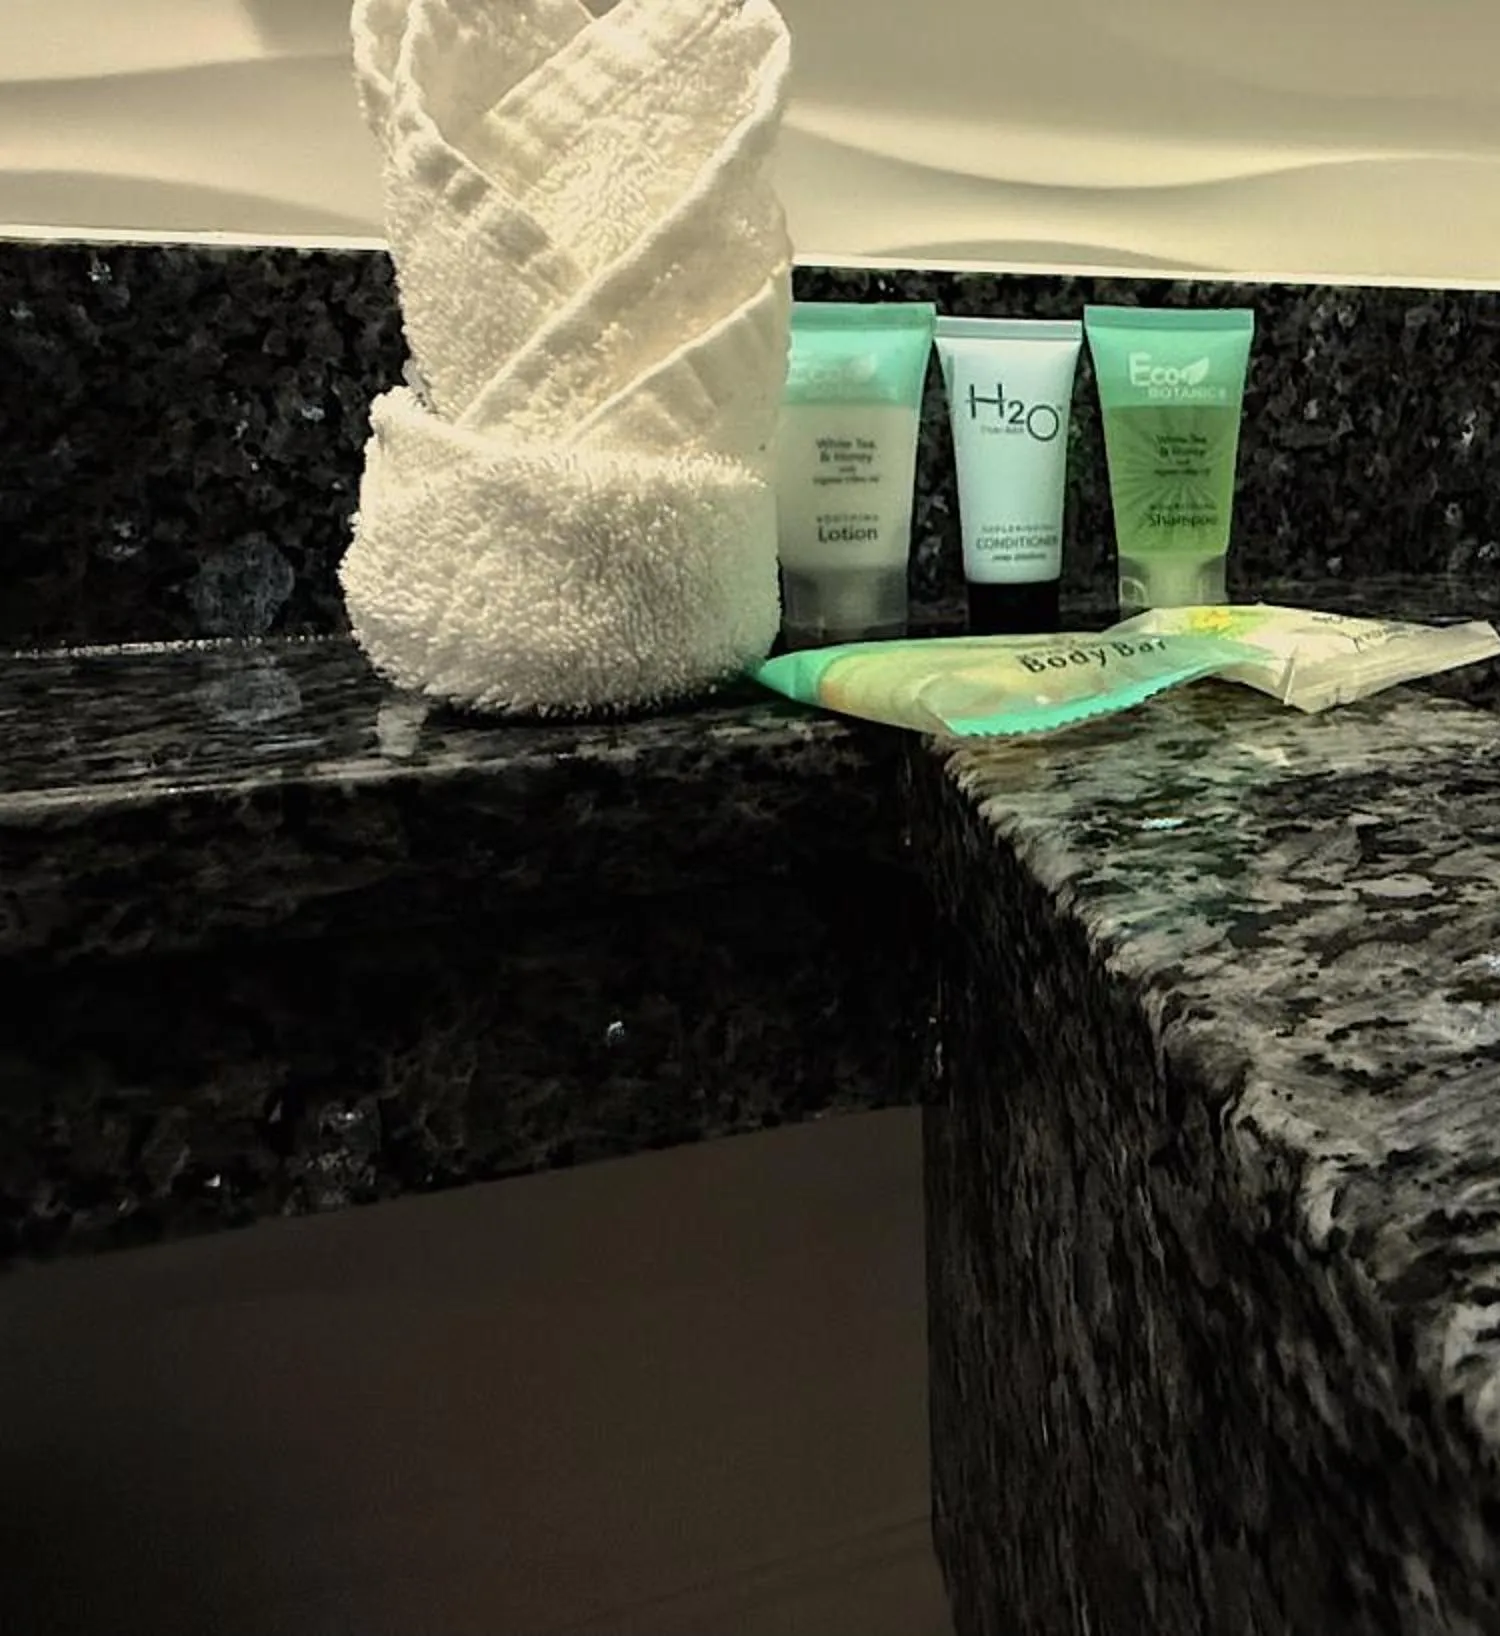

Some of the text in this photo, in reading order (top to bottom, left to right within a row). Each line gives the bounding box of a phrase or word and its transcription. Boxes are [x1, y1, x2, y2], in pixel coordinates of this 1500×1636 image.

[1128, 352, 1180, 386] Eco
[965, 383, 1059, 442] H2O
[818, 525, 879, 543] Lotion
[1018, 640, 1166, 673] Body Bar
